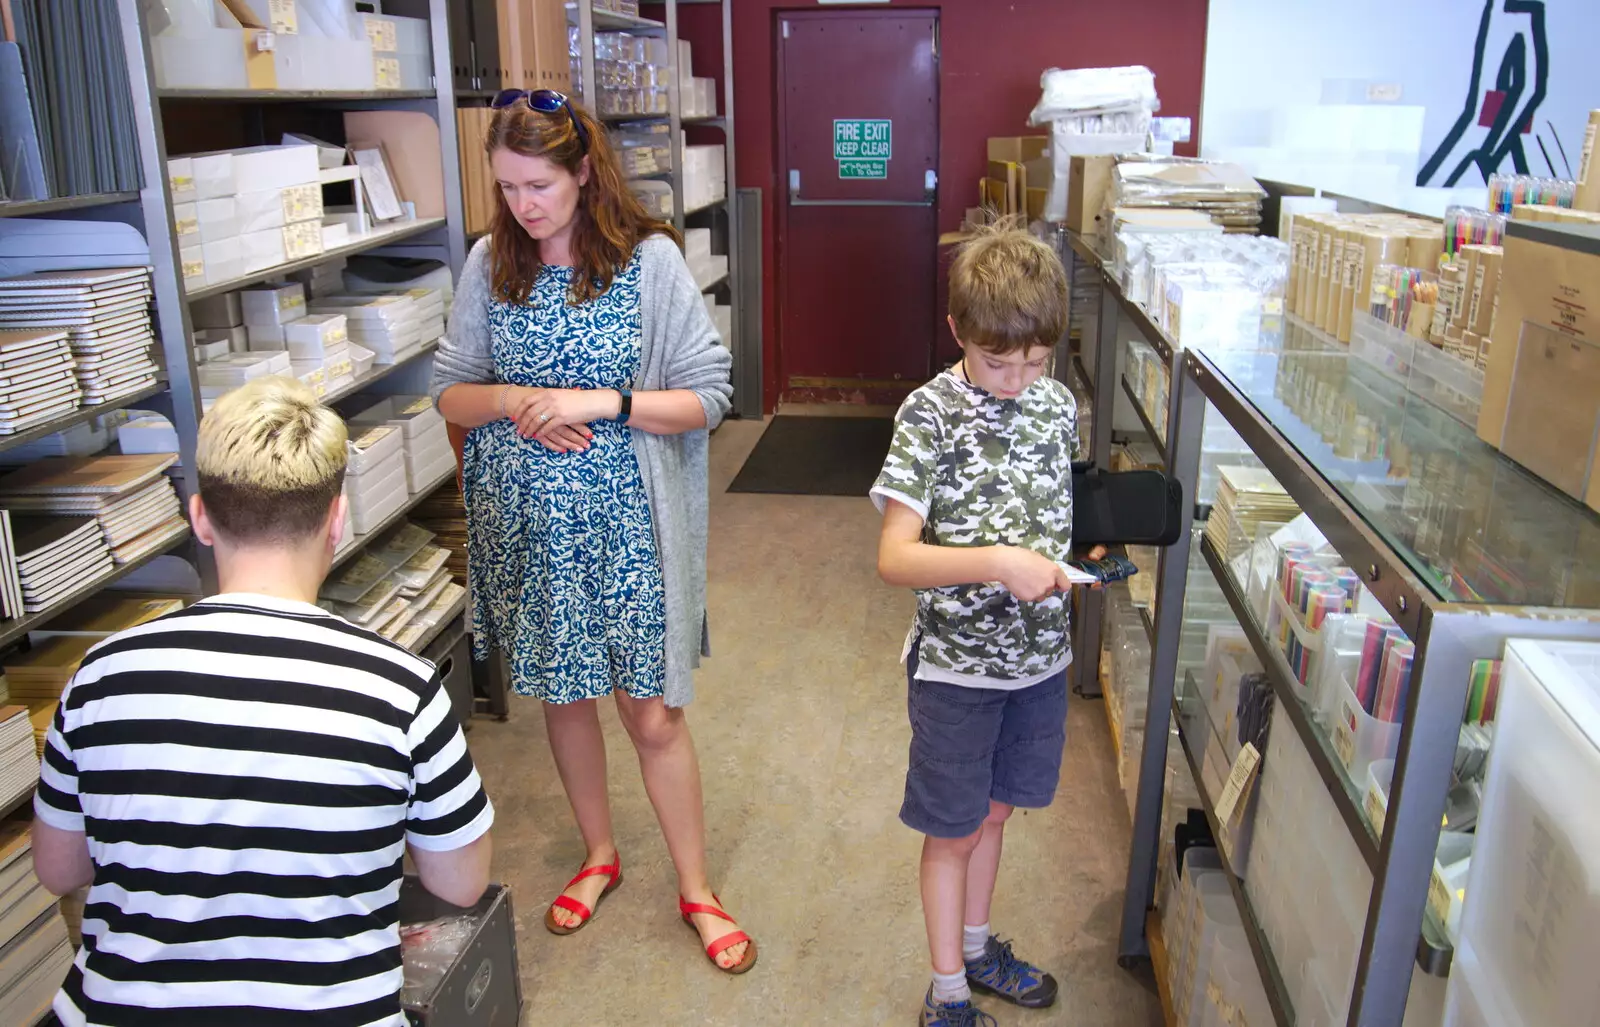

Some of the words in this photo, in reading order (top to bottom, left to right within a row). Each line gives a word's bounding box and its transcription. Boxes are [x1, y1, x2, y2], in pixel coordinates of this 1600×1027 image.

[836, 123, 860, 140] FIRE
[864, 123, 888, 140] EXIT
[836, 141, 859, 156] KEEP
[861, 141, 889, 156] CLEAR
